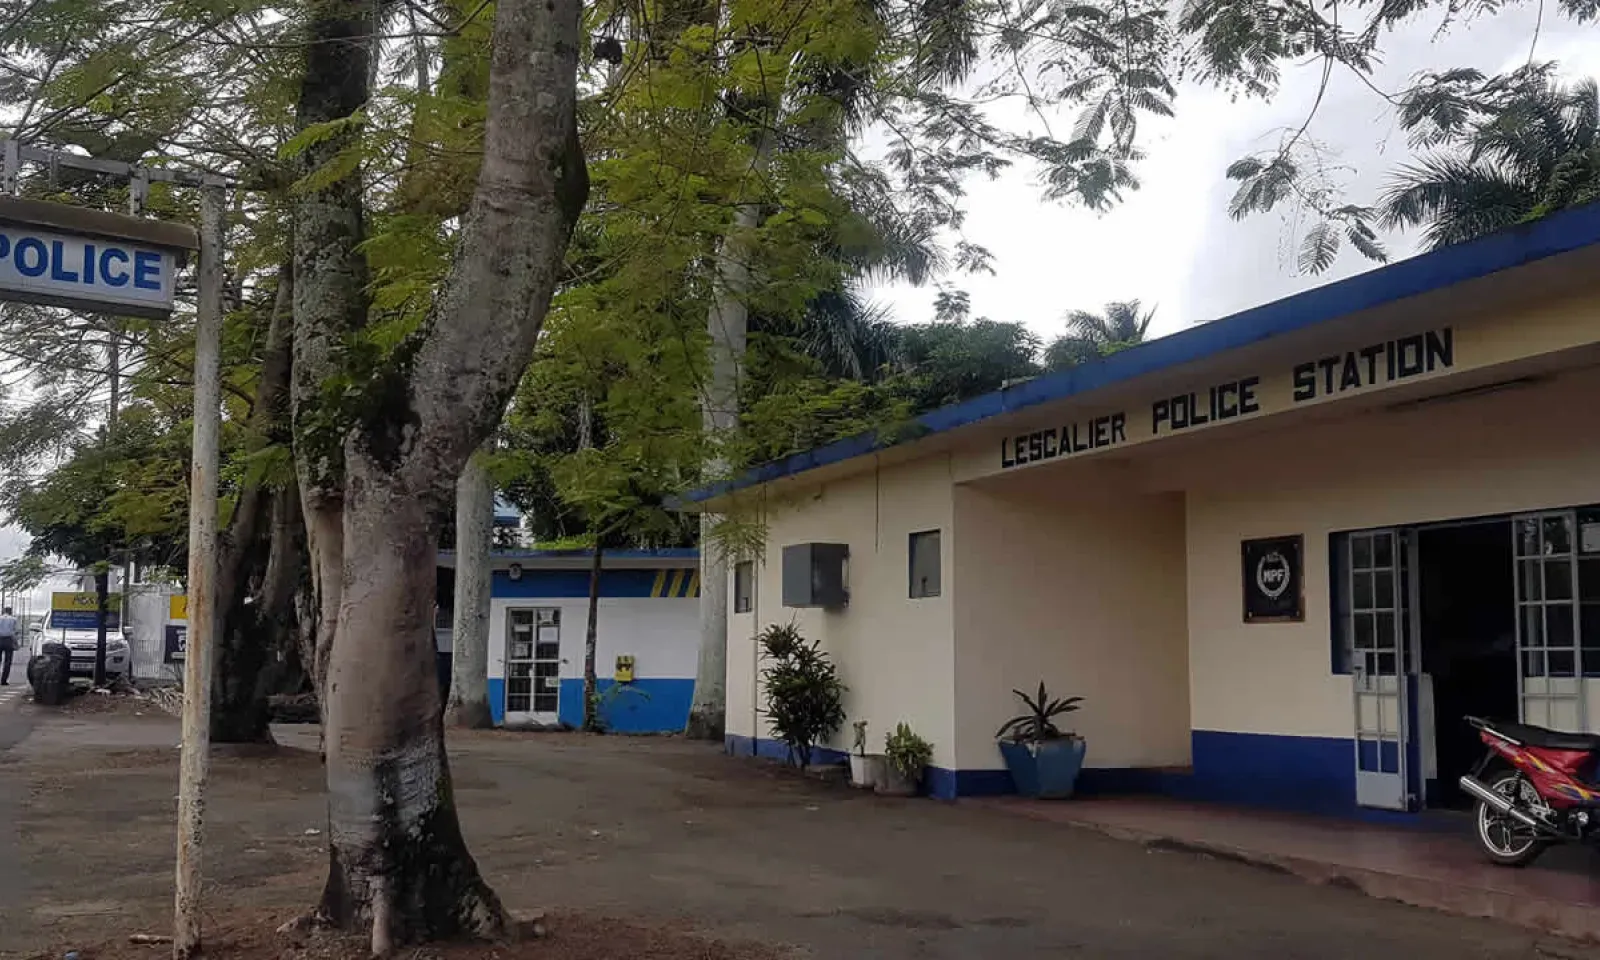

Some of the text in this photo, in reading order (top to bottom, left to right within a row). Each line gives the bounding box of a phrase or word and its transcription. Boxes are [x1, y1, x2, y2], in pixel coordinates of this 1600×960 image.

[1001, 328, 1453, 468] LESCALIER POLICE STATION
